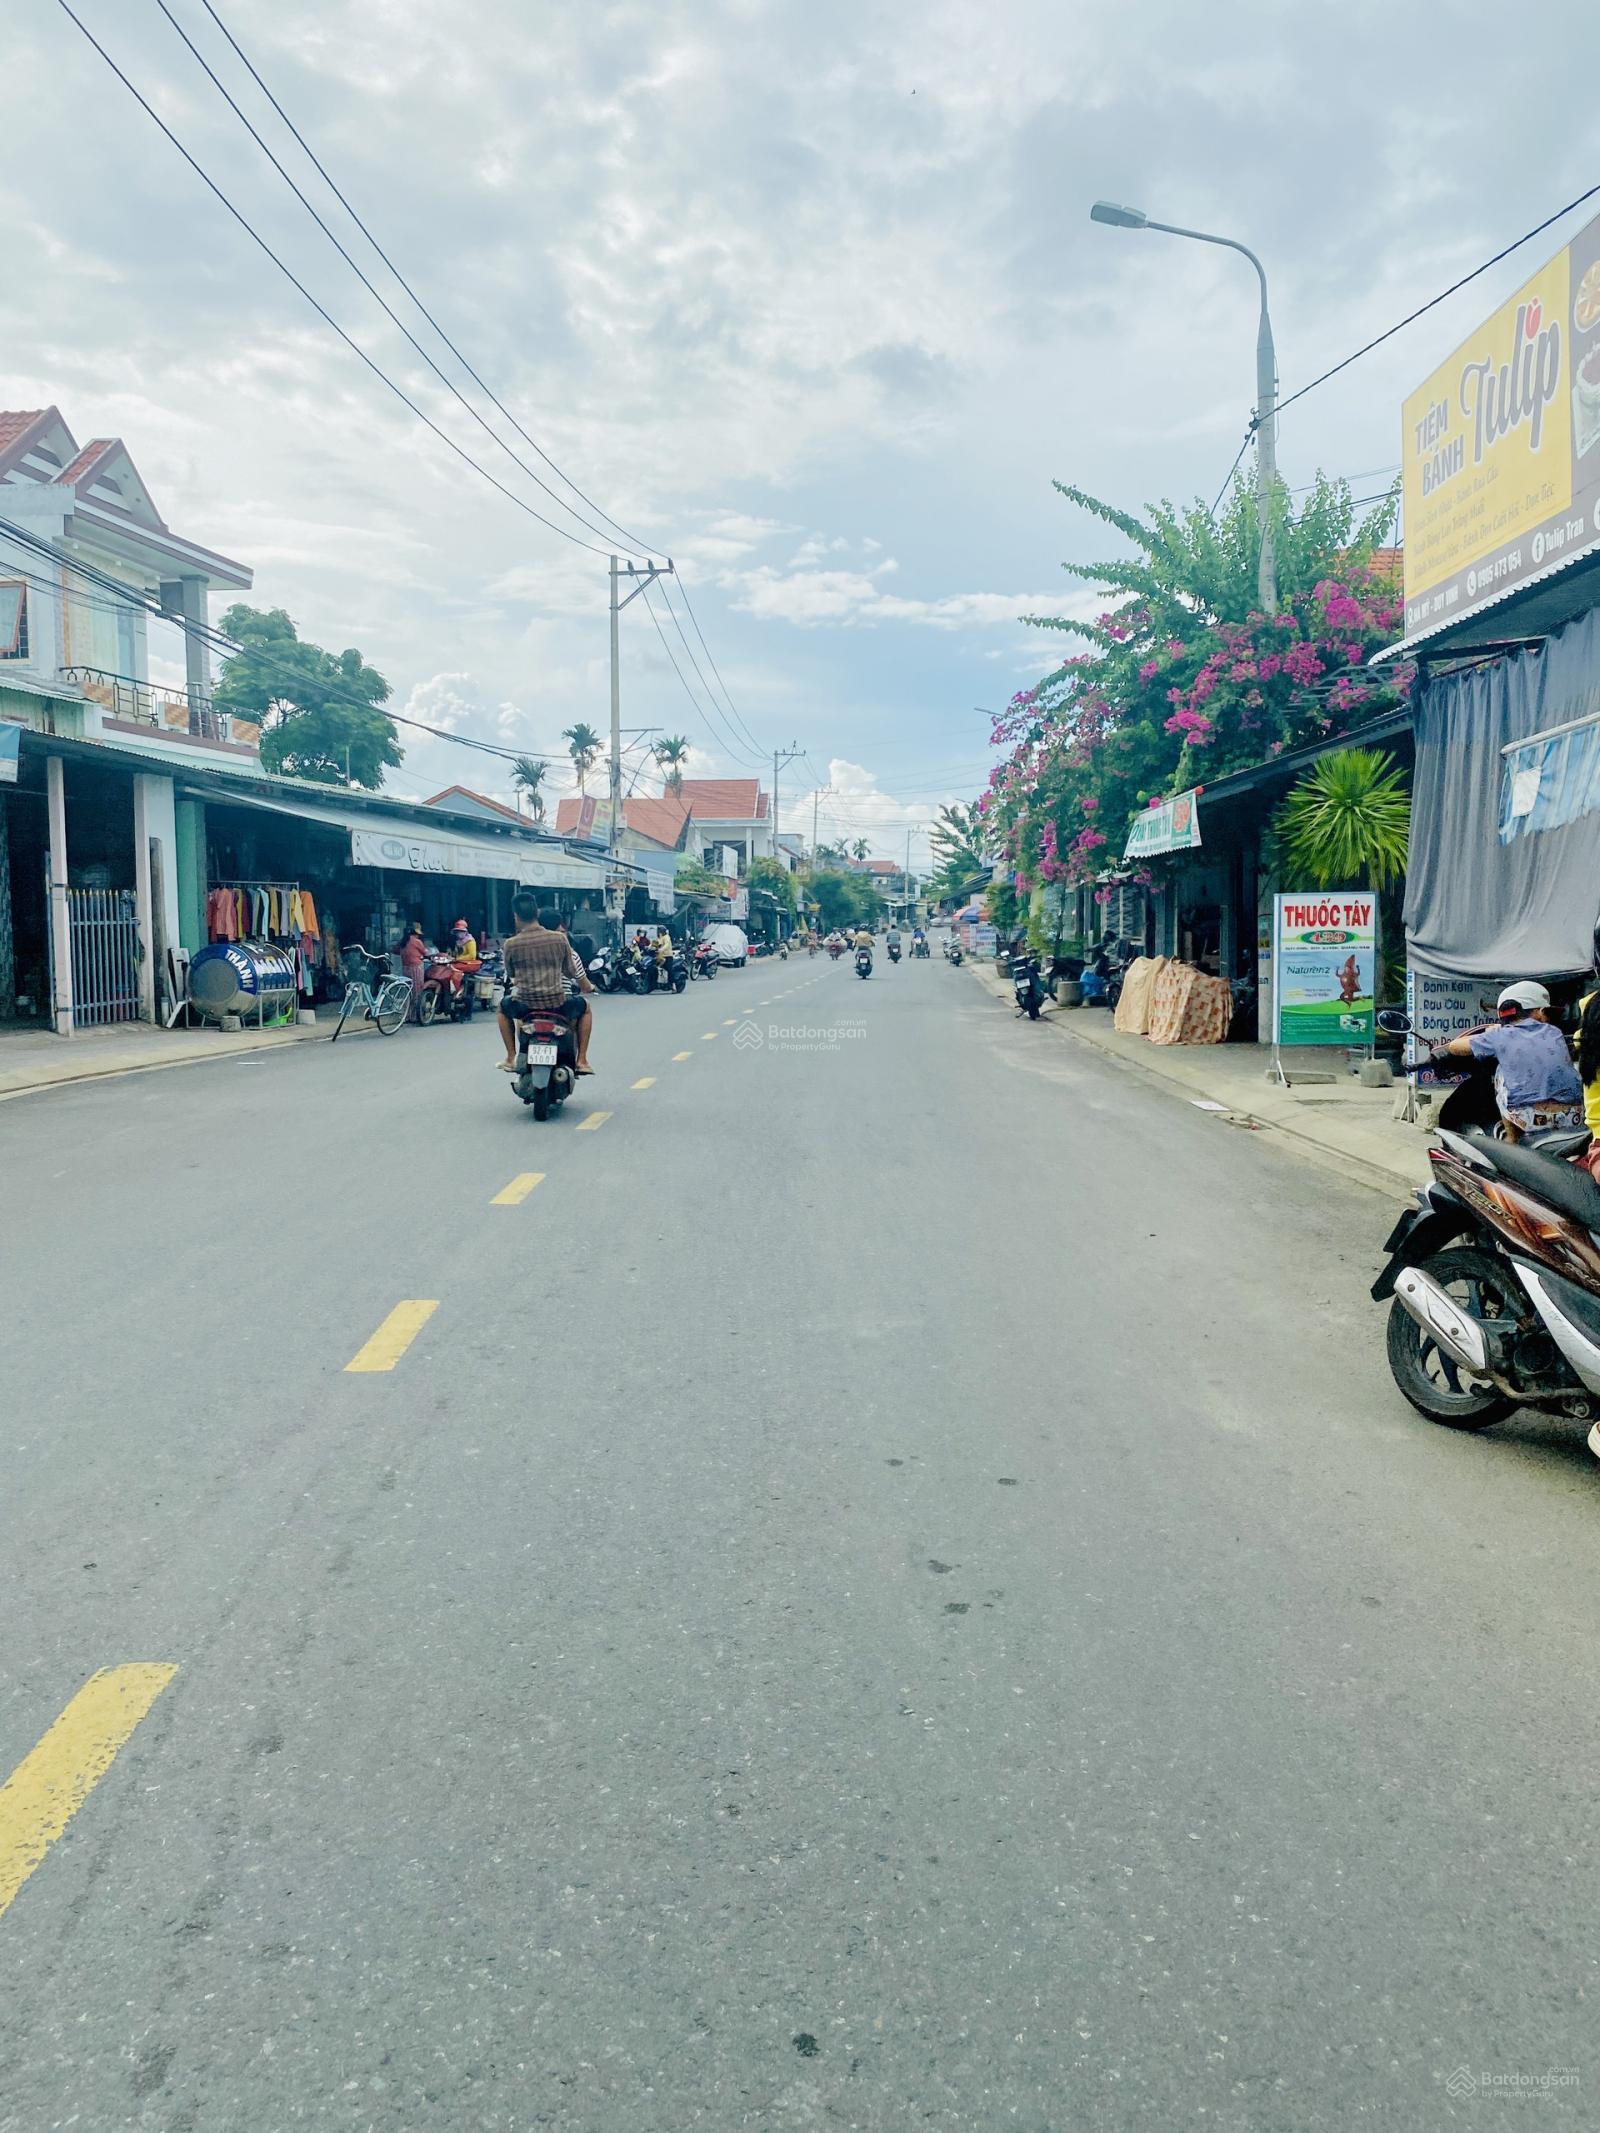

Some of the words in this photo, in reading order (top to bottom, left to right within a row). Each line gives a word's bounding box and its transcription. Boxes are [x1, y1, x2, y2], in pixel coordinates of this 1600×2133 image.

[1460, 304, 1560, 463] Tulip
[1415, 398, 1448, 455] TIỆM
[1423, 433, 1464, 496] BÁNH
[1545, 527, 1565, 552] Tulip
[1284, 898, 1342, 927] THUỐC
[1344, 900, 1371, 926] TÂY
[1453, 1016, 1471, 1028] Lan
